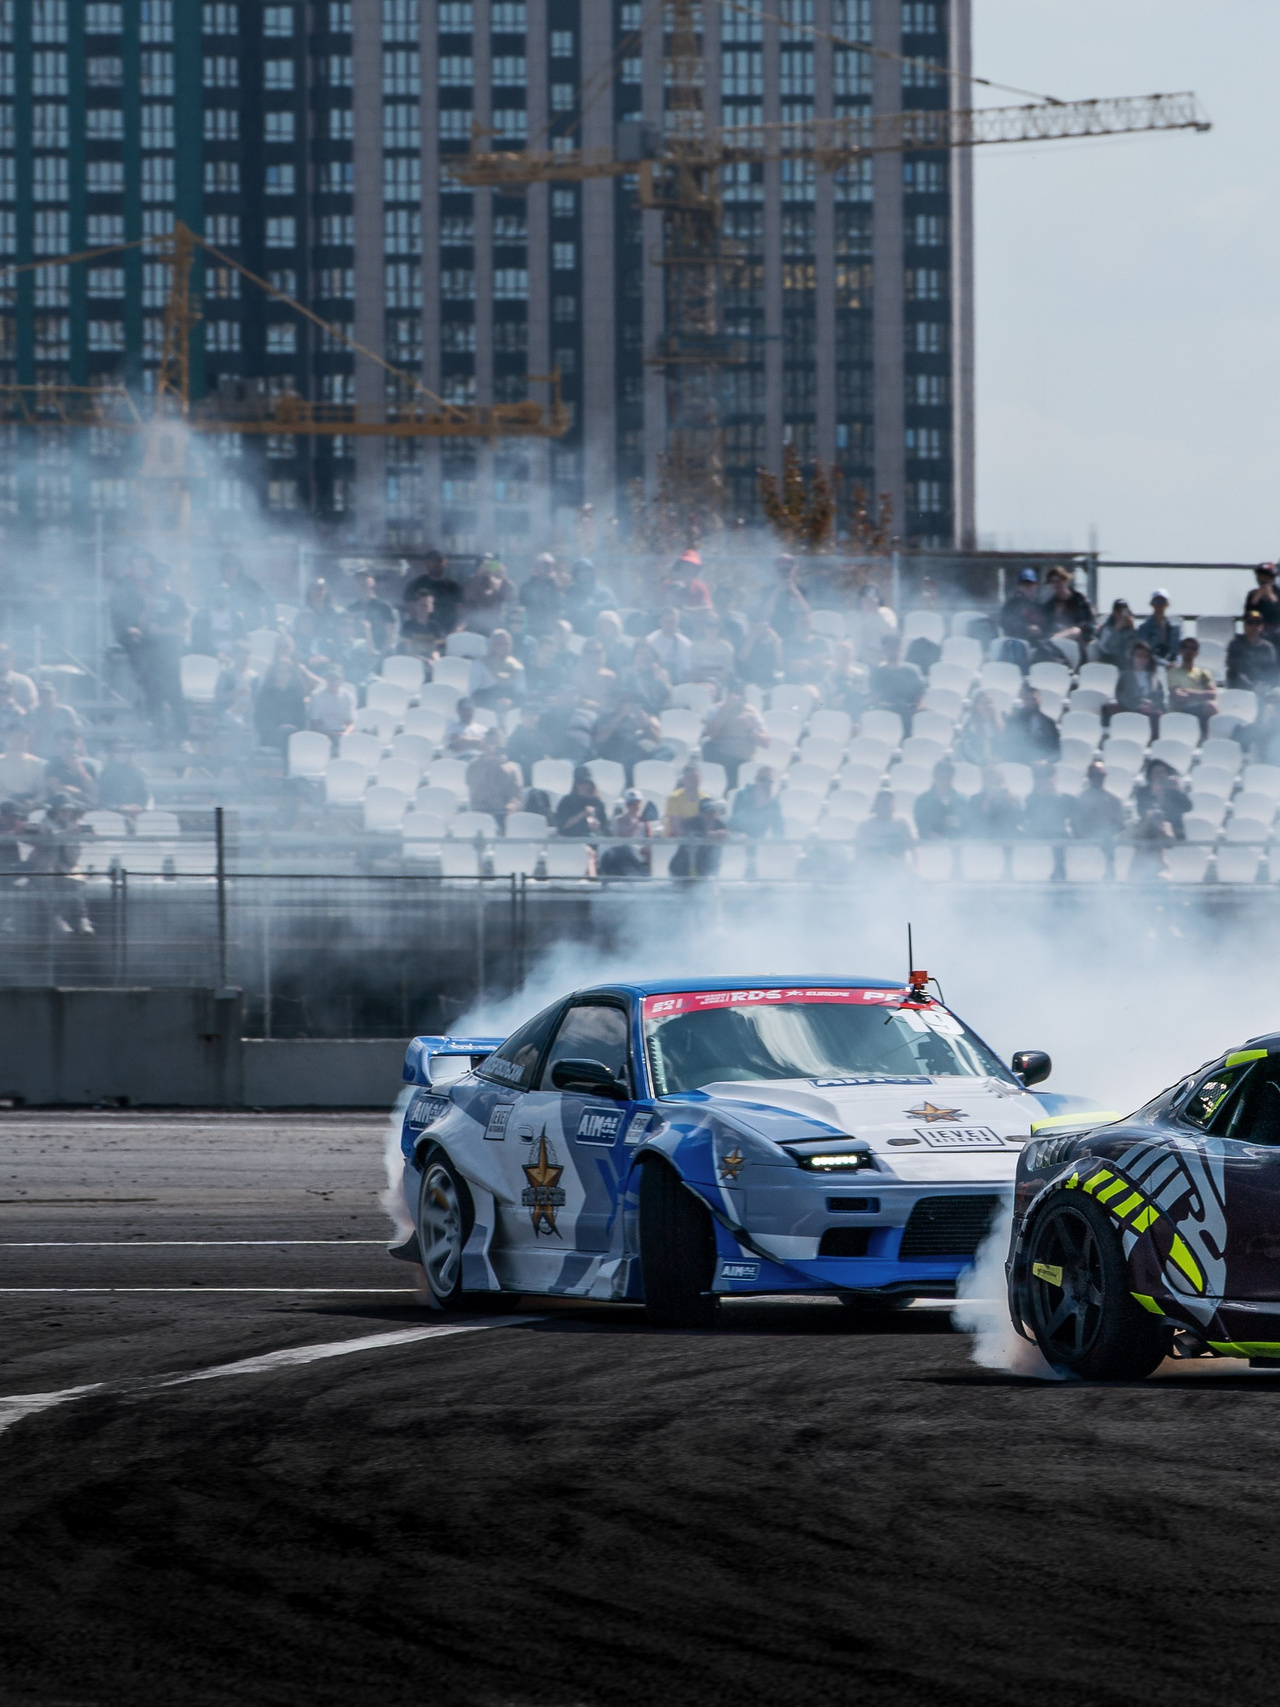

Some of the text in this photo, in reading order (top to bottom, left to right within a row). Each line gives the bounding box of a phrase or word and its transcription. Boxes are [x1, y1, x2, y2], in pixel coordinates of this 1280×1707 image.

[731, 990, 782, 1001] RDS
[887, 1009, 965, 1035] 19
[577, 1114, 619, 1138] AIMOL
[722, 1265, 756, 1278] AIMOL
